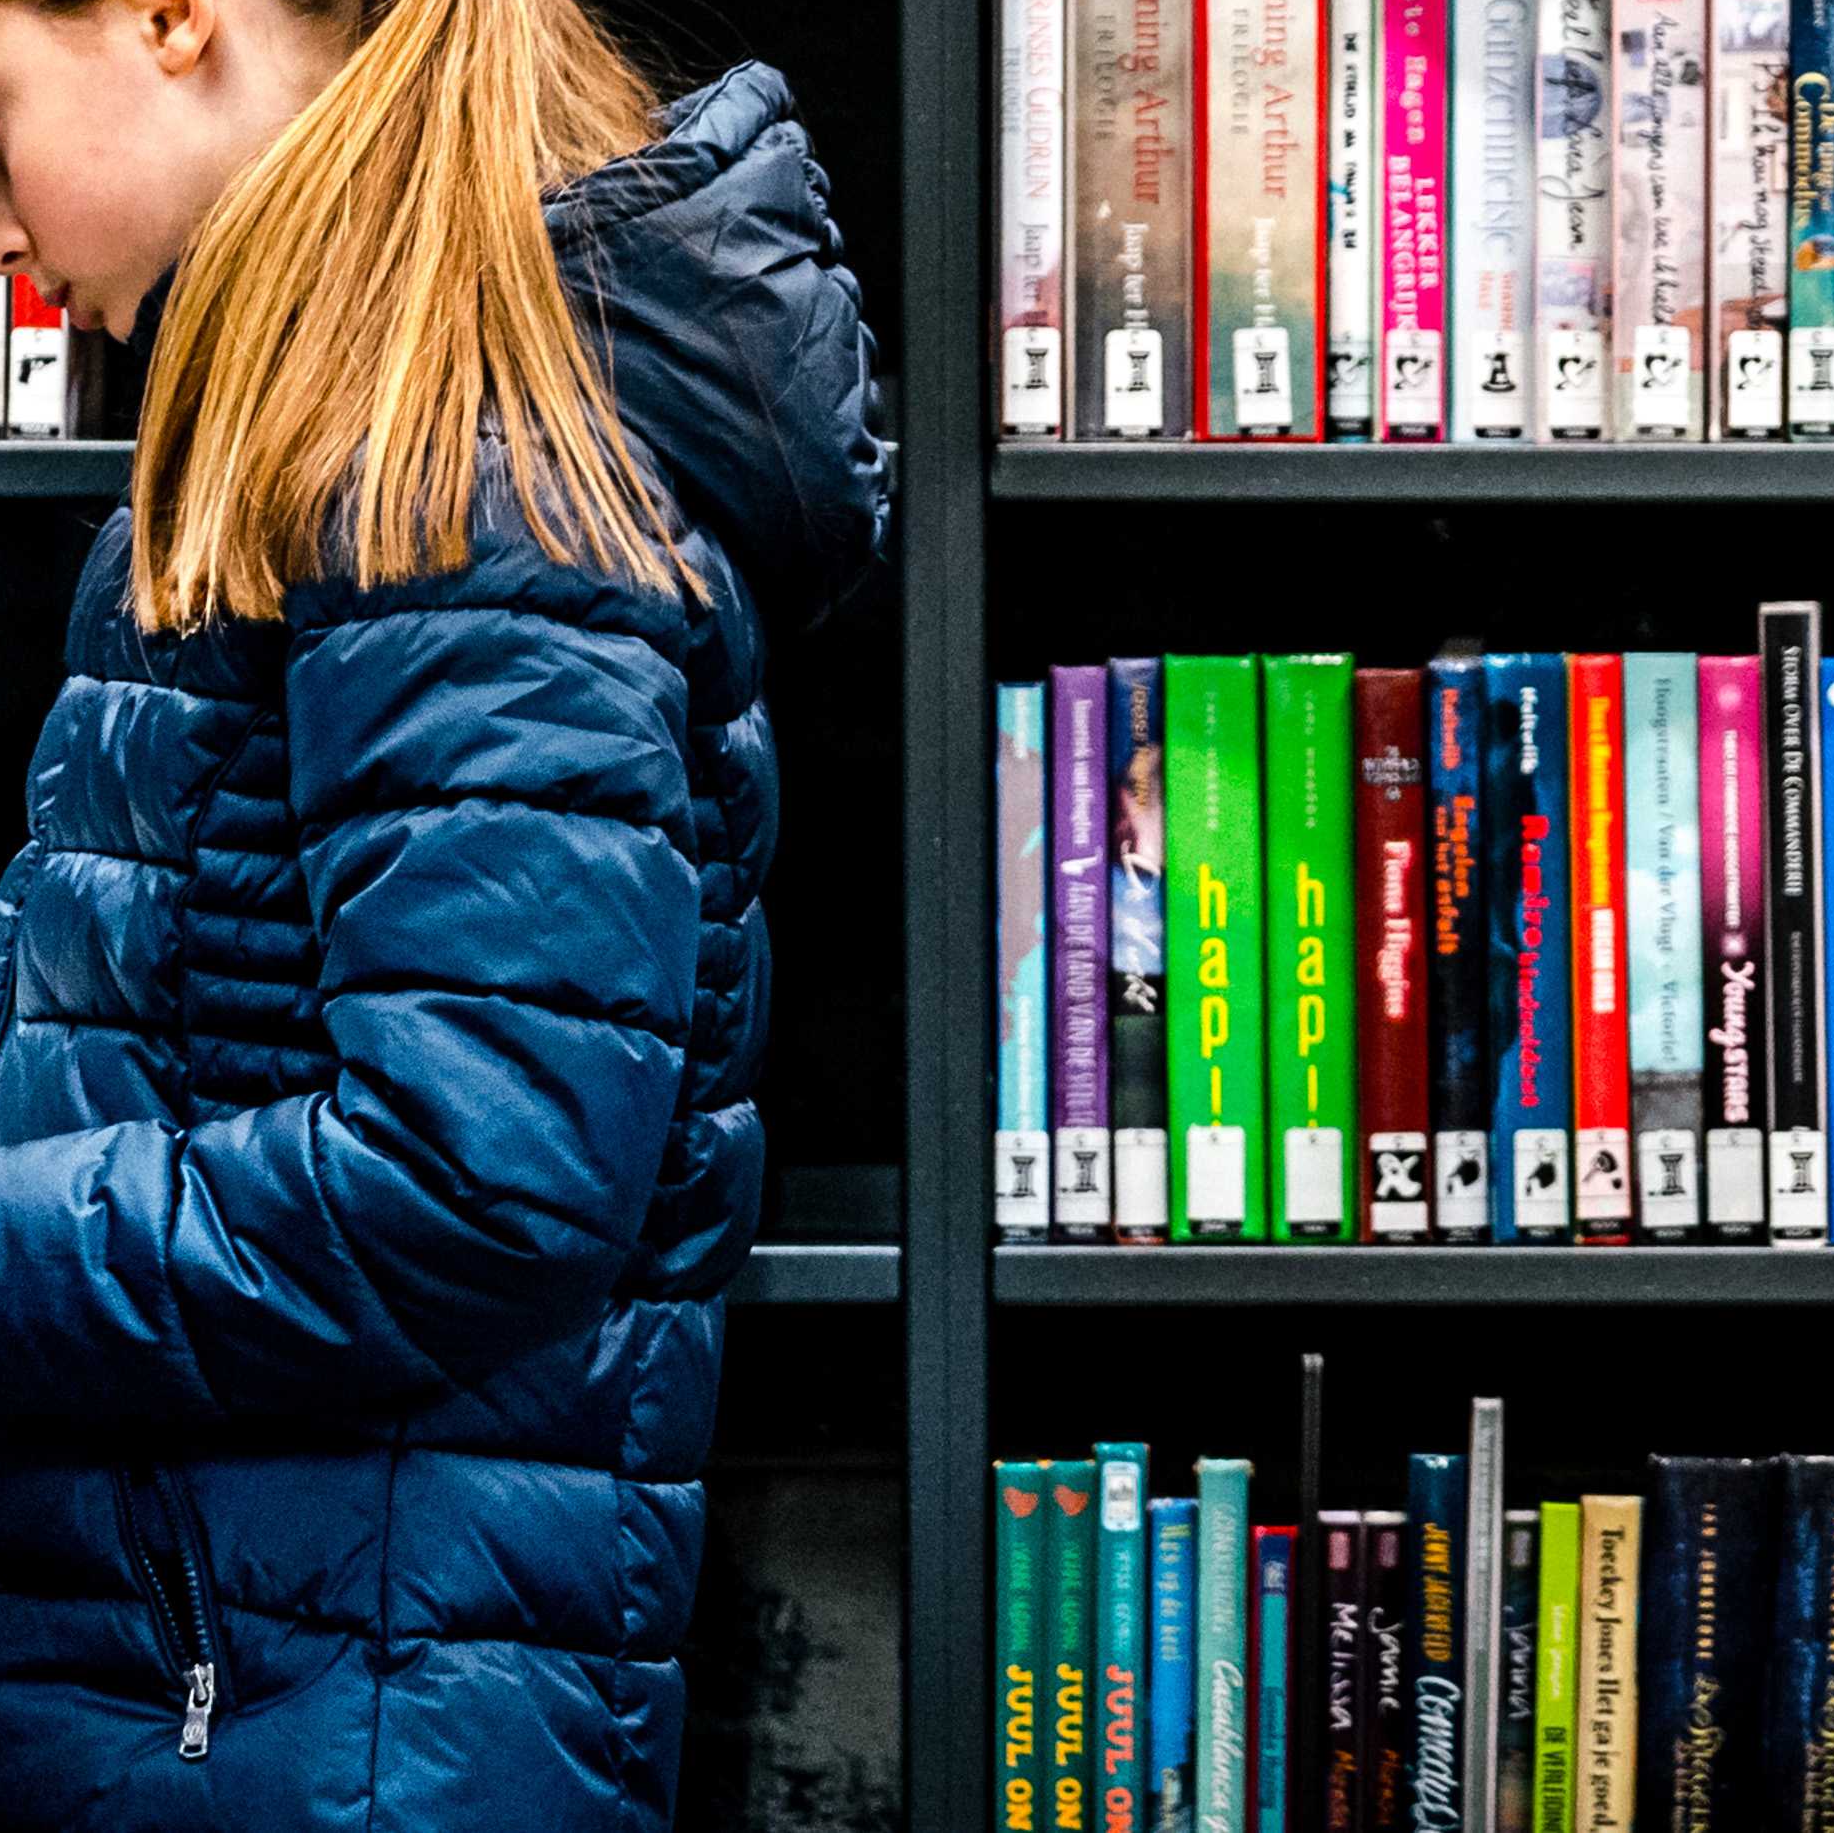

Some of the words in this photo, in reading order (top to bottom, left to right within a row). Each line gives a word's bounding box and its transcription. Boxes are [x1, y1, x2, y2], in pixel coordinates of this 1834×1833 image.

[1132, 88, 1172, 207] Arthur
[1260, 84, 1301, 202] Arthur
[1793, 71, 1831, 230] Commodus
[1121, 222, 1151, 270] Jaap
[1414, 176, 1439, 290] LEKKER
[1123, 274, 1149, 306] ter
[1384, 840, 1412, 913] Fiona
[1520, 814, 1550, 948] Ramiro
[1329, 1602, 1359, 1731] Melissa
[1595, 1617, 1623, 1674] Jones
[1005, 1664, 1033, 1768] JUUL
[1055, 1663, 1083, 1767] JUUL
[1104, 1664, 1135, 1775] JUUL
[1209, 1659, 1244, 1810] Casablanca
